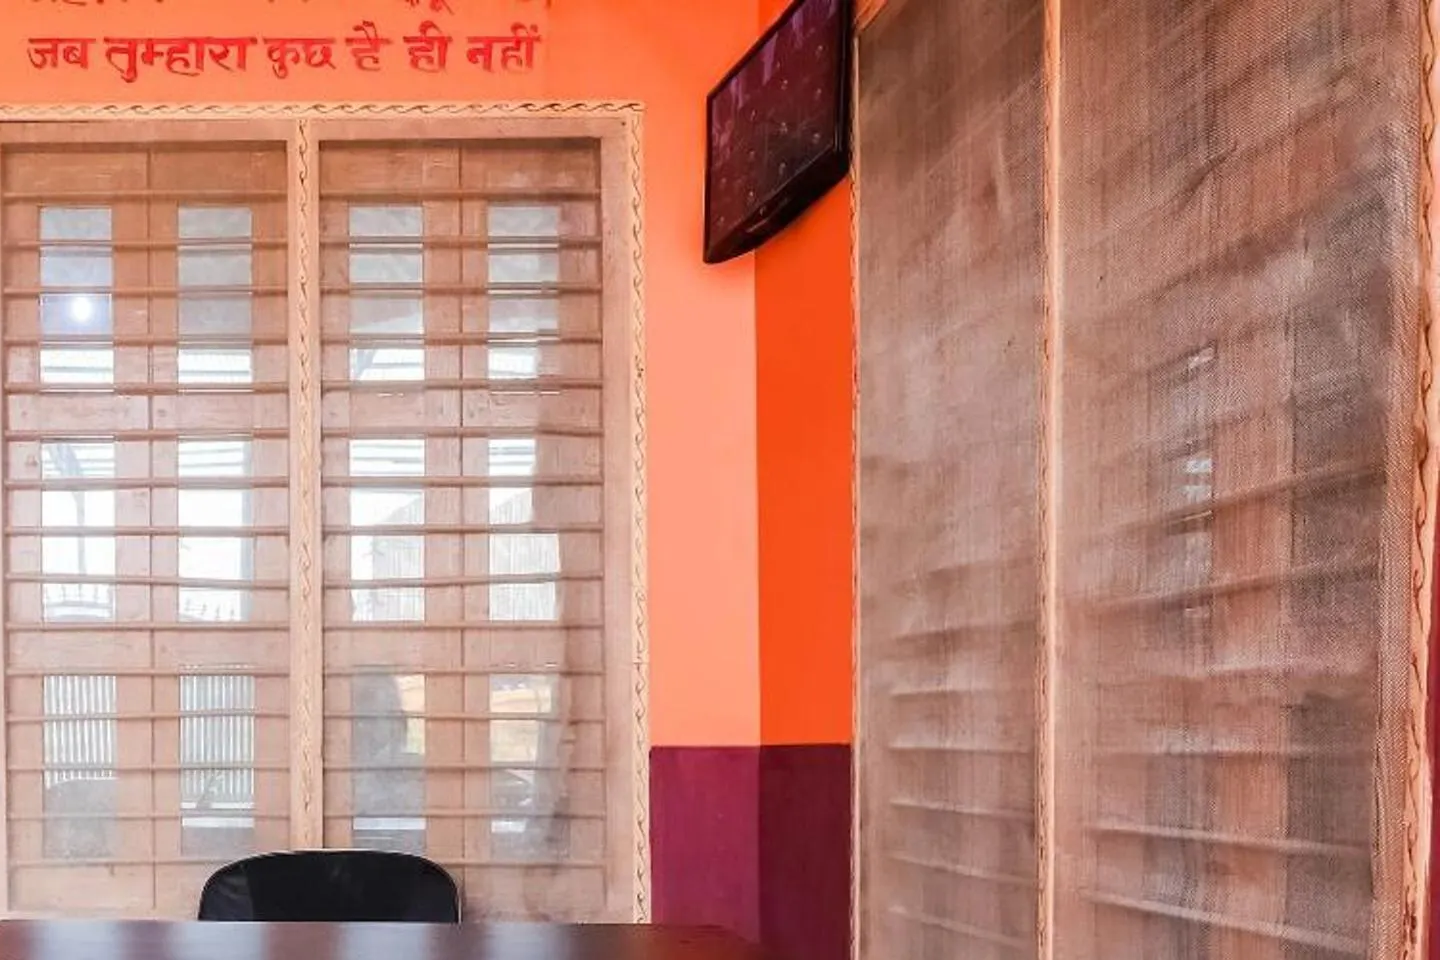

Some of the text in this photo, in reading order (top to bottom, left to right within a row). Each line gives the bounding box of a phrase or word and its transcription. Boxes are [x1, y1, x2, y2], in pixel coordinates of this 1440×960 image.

[27, 20, 541, 83] जब तुम्हारा कुछ है ही नहीं
